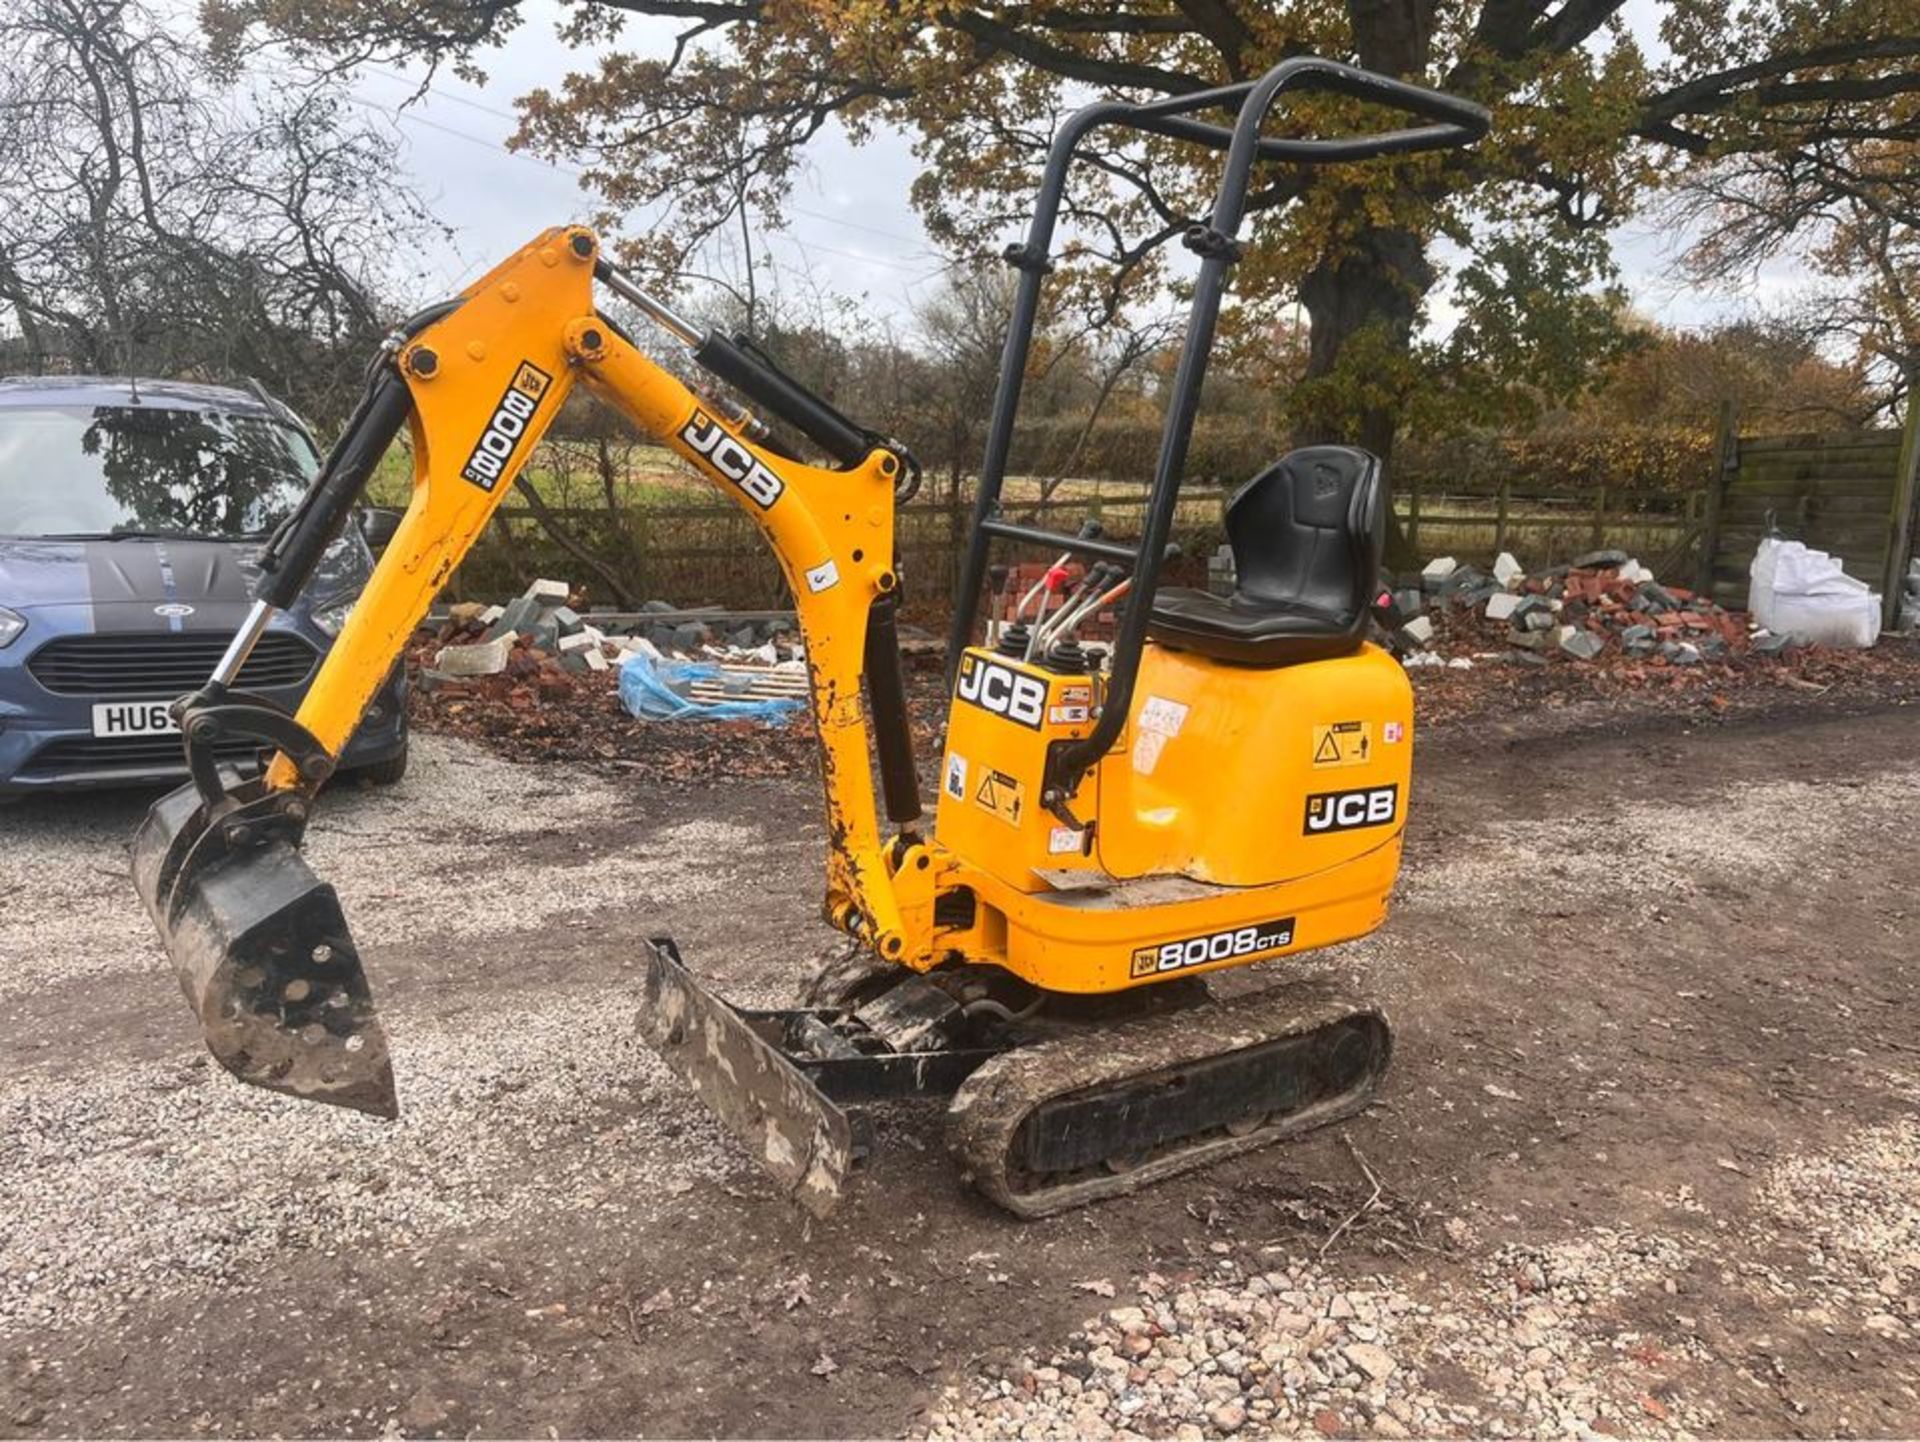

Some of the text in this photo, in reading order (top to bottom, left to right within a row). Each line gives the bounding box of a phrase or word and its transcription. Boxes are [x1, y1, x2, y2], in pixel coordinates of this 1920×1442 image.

[683, 423, 783, 506] JCB
[958, 660, 1046, 726] JCB
[1308, 789, 1395, 830] JCB
